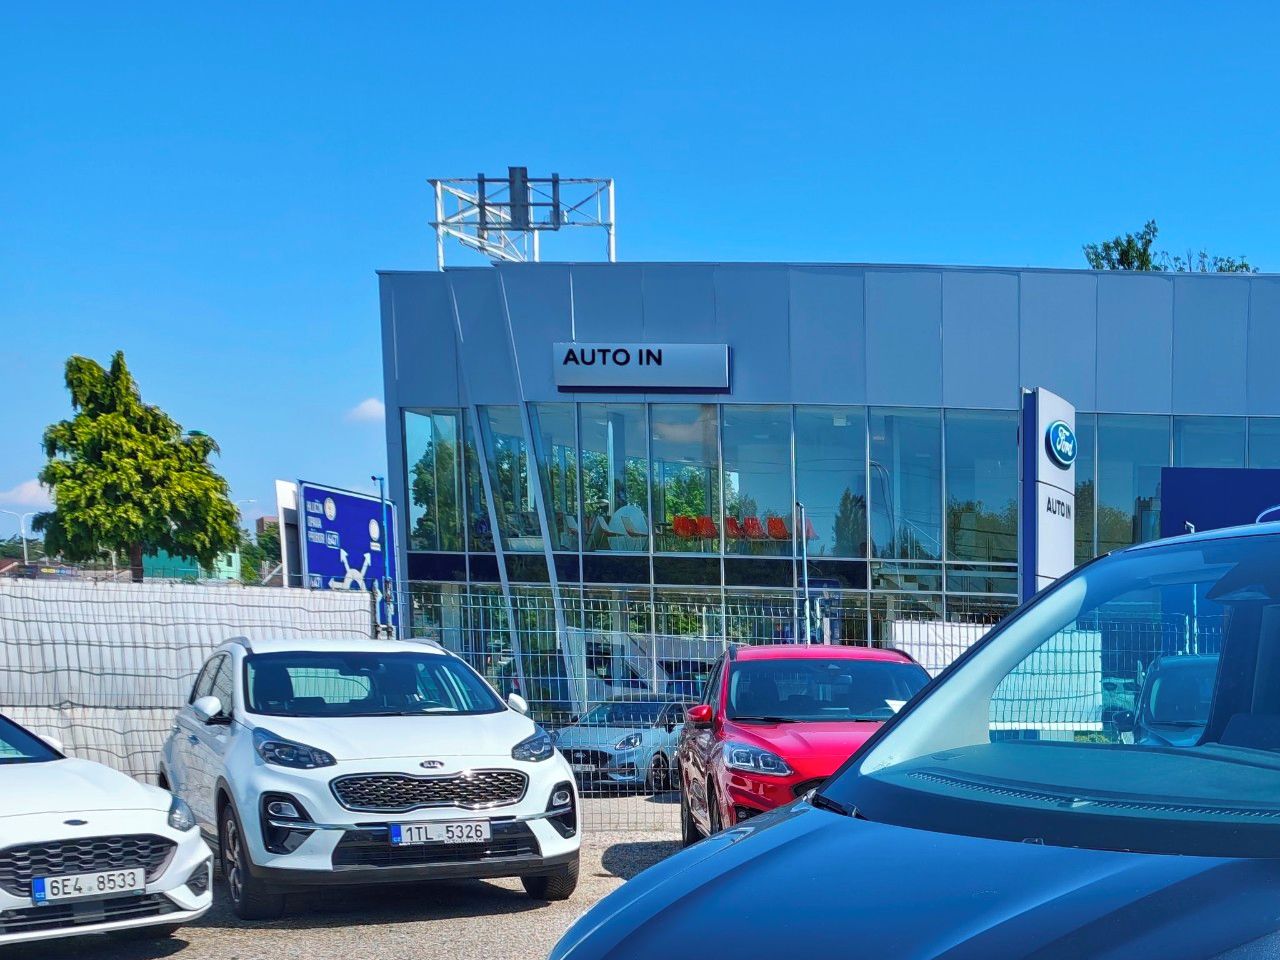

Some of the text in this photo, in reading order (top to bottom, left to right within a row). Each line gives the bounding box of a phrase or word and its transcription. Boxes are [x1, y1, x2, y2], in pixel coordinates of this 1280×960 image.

[563, 348, 662, 366] AUTO IN
[1056, 426, 1074, 456] Ford
[1047, 497, 1072, 519] AUTO IN
[406, 824, 483, 841] 1TL 5326
[50, 872, 136, 896] 6E4 8533
